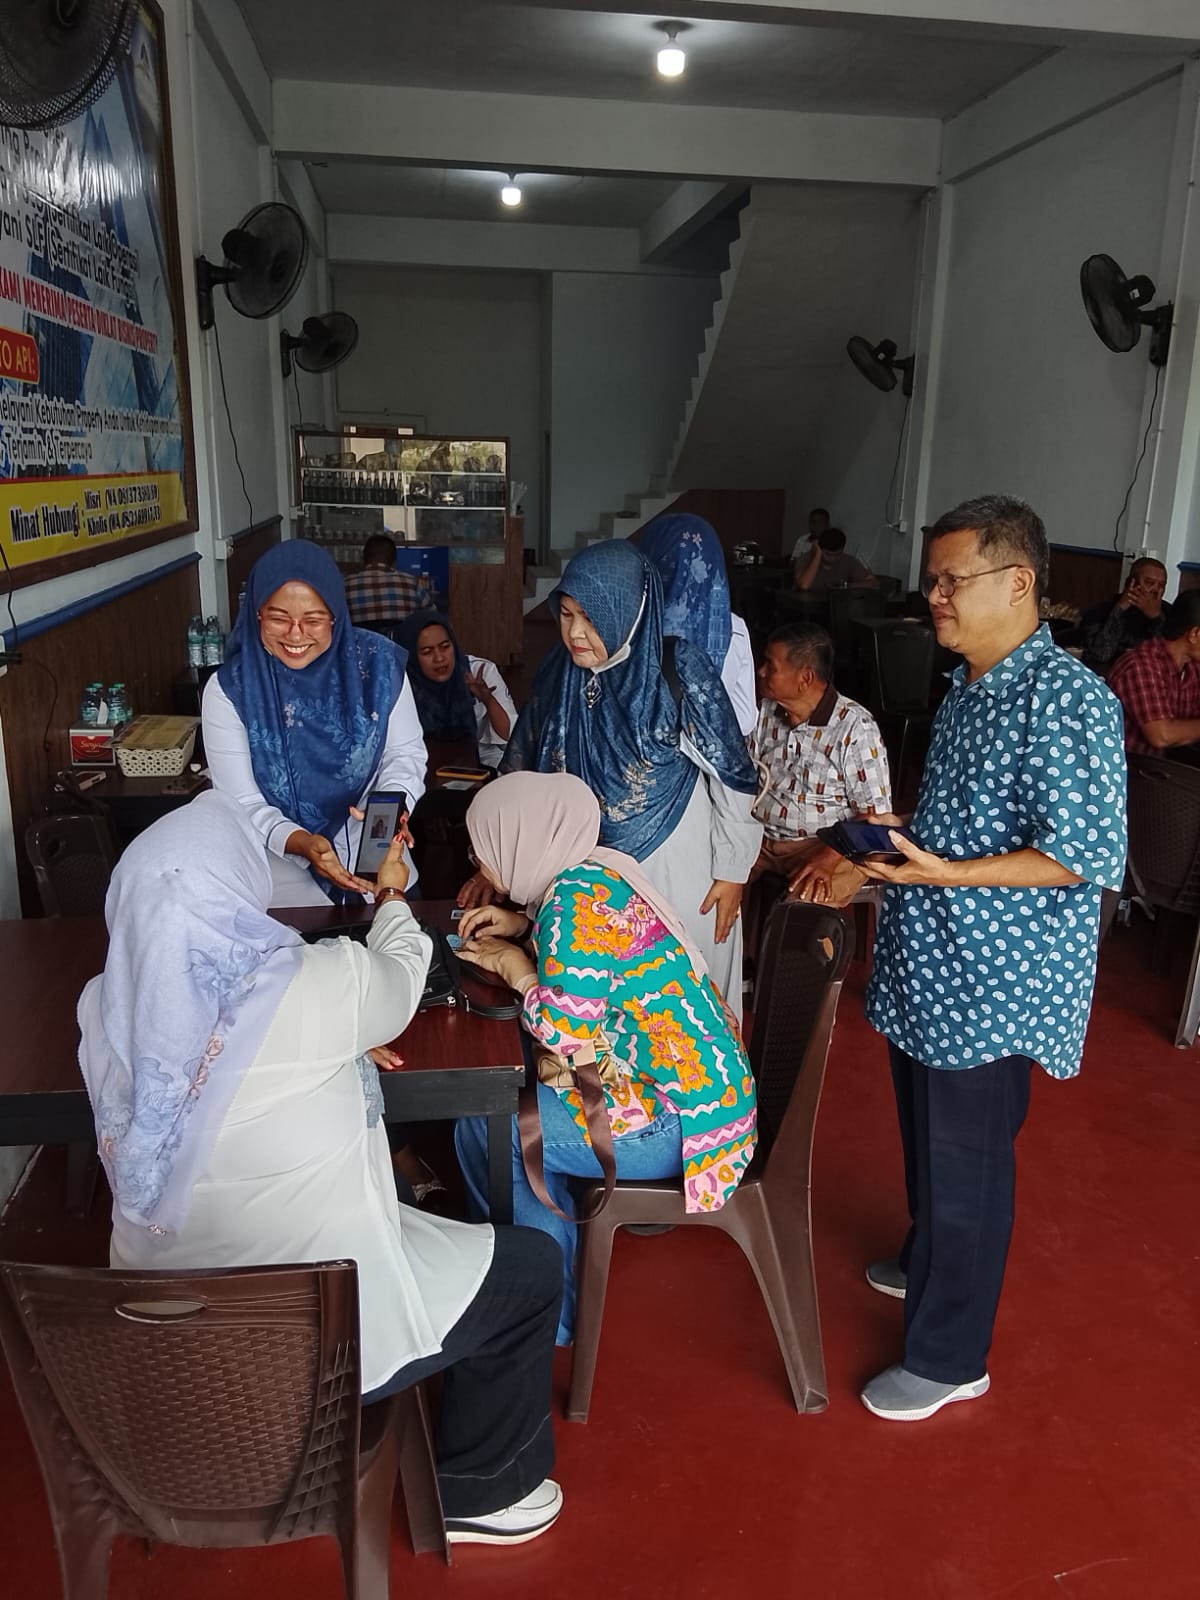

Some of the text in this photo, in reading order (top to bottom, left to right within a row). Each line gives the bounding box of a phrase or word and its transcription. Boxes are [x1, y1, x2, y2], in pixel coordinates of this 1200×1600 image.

[25, 213, 44, 254] SLF
[93, 254, 110, 288] Laik
[23, 277, 66, 321] MENERIMA
[16, 344, 36, 375] API:
[0, 394, 34, 425] elayani
[36, 398, 76, 428] Kebutuhan
[47, 435, 55, 460] &
[10, 508, 40, 542] Minat
[43, 502, 80, 538] Hubungi
